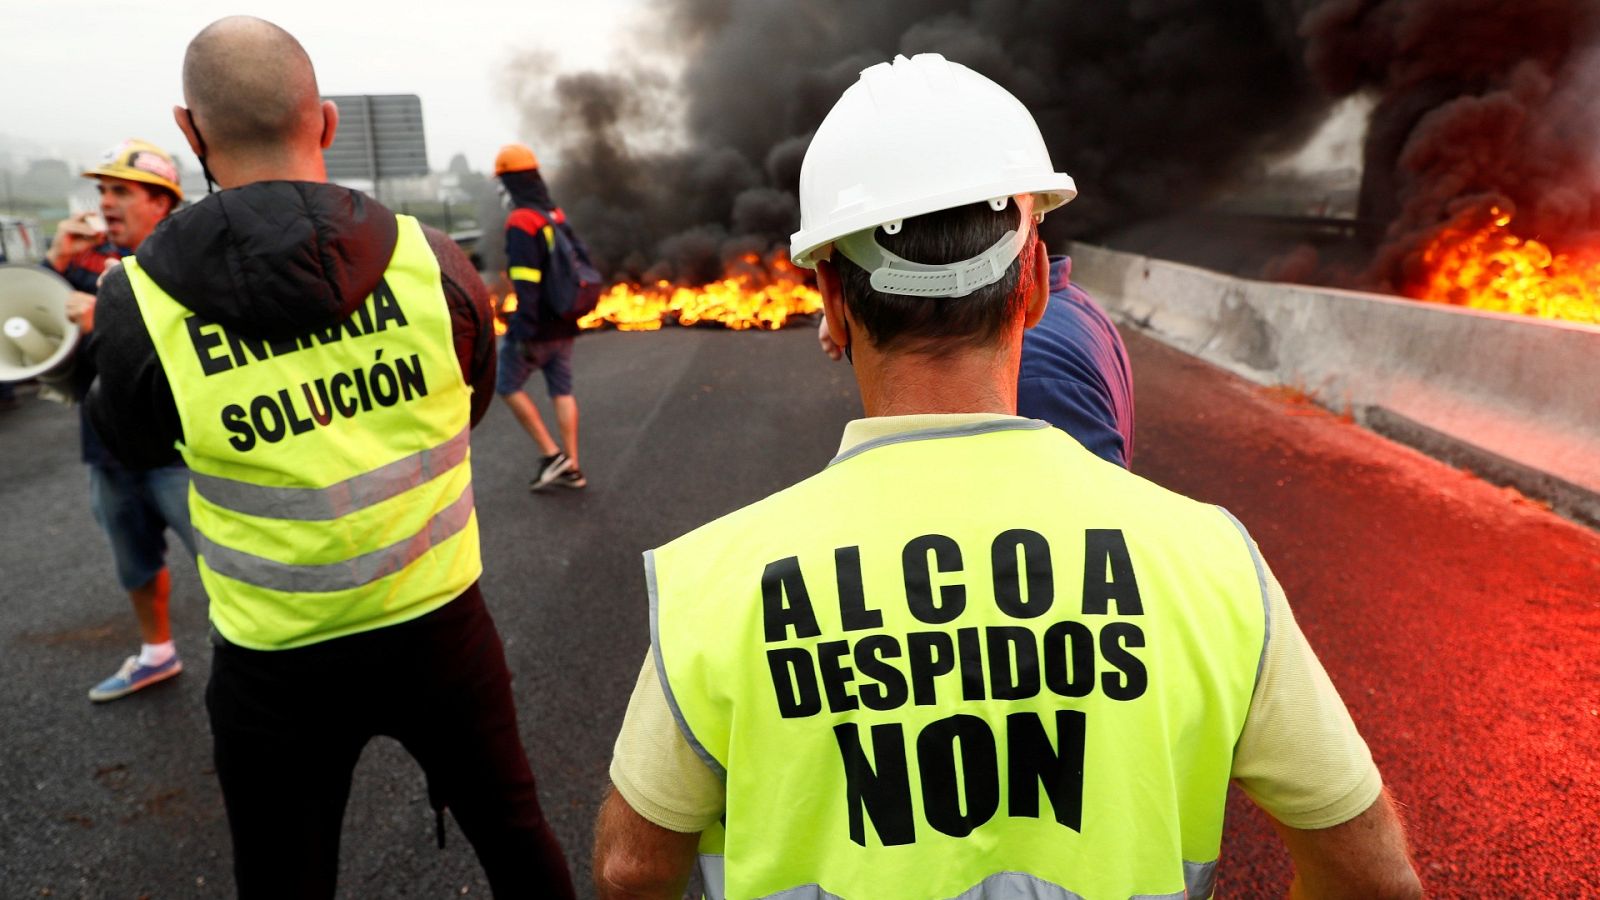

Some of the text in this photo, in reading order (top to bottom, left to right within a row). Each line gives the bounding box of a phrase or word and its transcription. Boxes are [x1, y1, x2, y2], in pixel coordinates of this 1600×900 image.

[184, 277, 408, 377] ENIA
[221, 349, 428, 452] SOLUCIÓN
[761, 528, 1144, 643] ALCOA
[766, 620, 1148, 718] DESPIDOS
[833, 709, 1086, 847] NON
